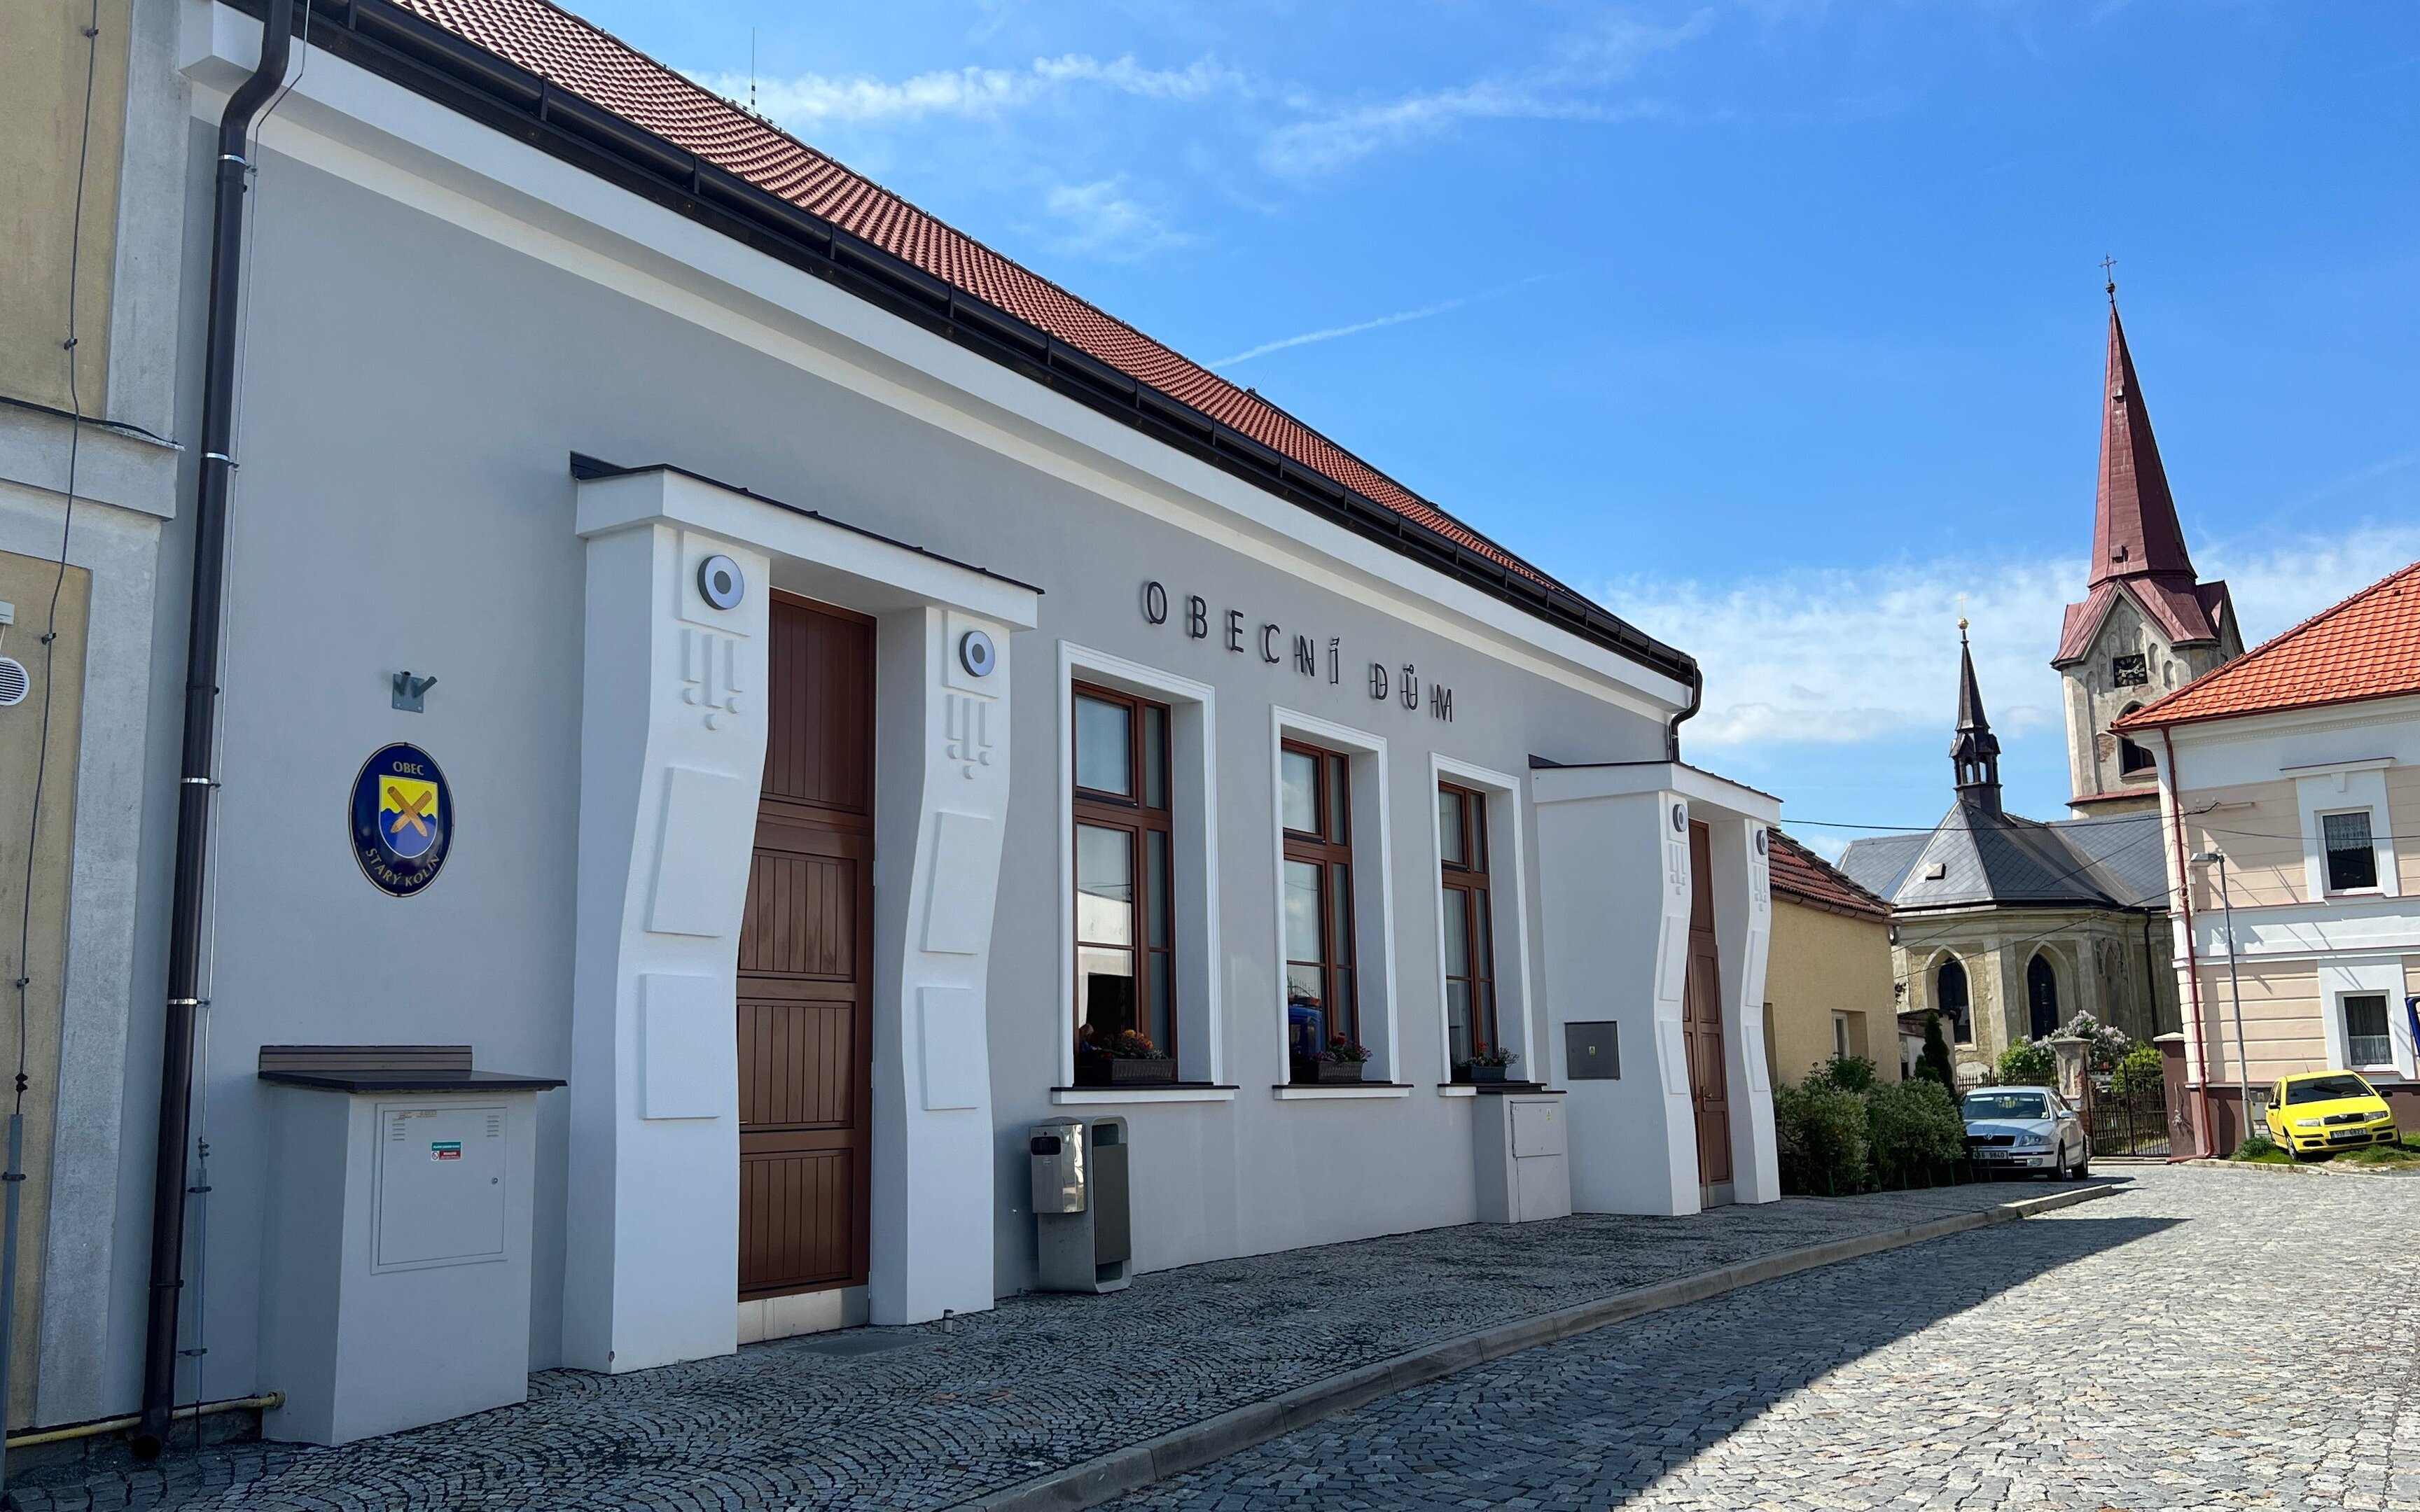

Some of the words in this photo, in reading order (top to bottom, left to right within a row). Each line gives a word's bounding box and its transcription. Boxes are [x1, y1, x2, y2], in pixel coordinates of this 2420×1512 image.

[1146, 580, 1341, 685] OBECNÍ
[1374, 663, 1454, 723] DŮM
[392, 761, 424, 776] OBEC
[366, 848, 401, 886] STARÝ
[405, 855, 440, 887] KOLÍN
